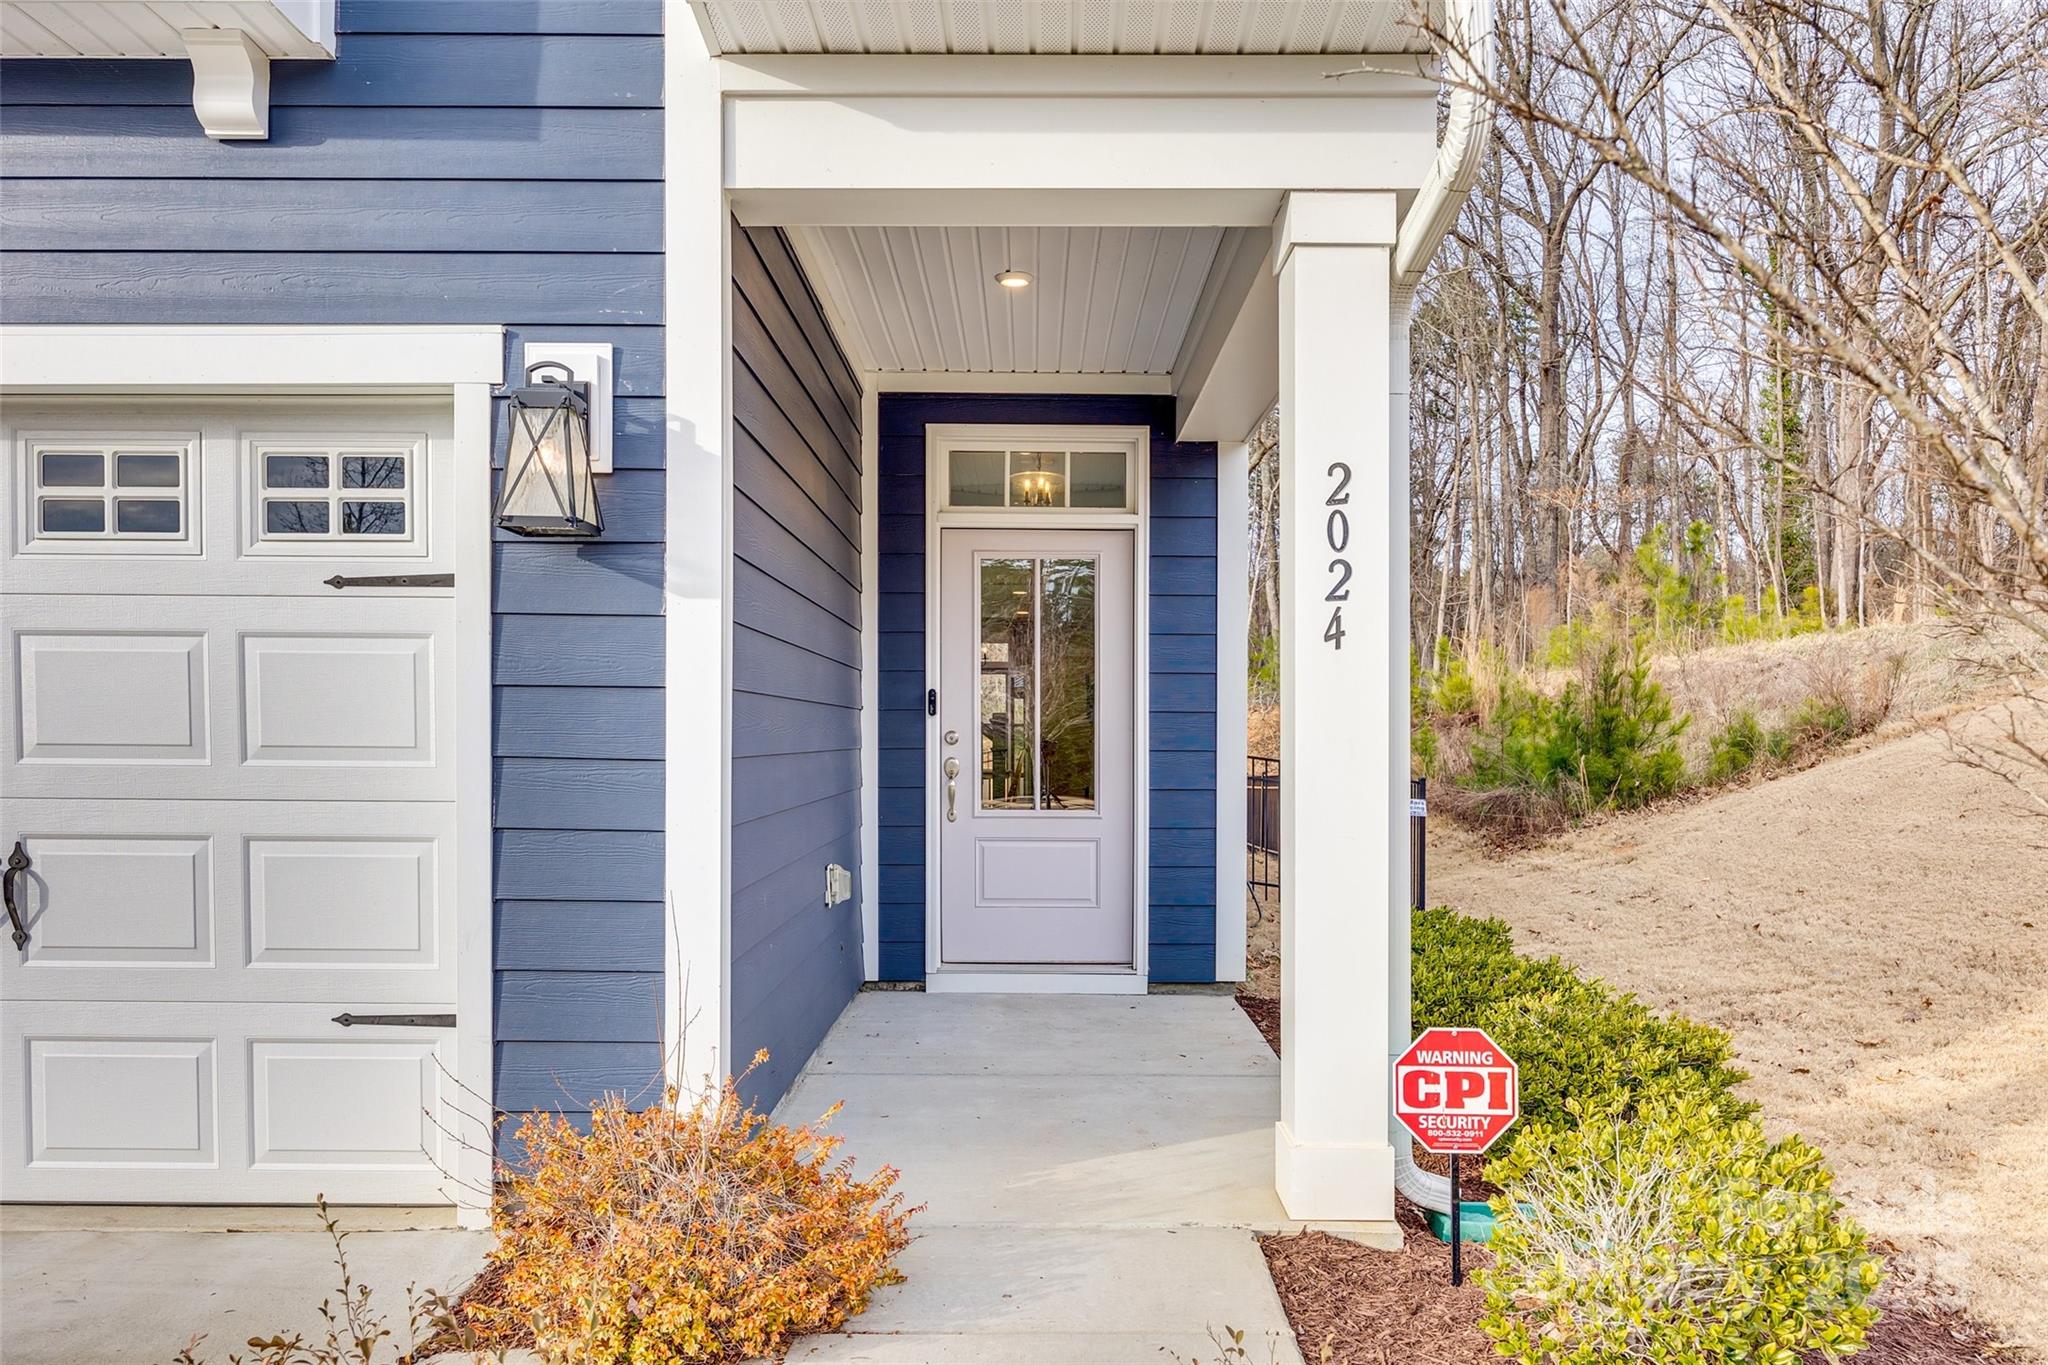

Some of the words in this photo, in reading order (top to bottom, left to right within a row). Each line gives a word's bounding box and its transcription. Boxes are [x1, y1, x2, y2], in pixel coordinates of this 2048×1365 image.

[1324, 462, 1352, 650] 2024
[1416, 1050, 1493, 1065] WARNING
[1403, 1070, 1508, 1110] CPI
[1418, 1115, 1491, 1129] SECURITY
